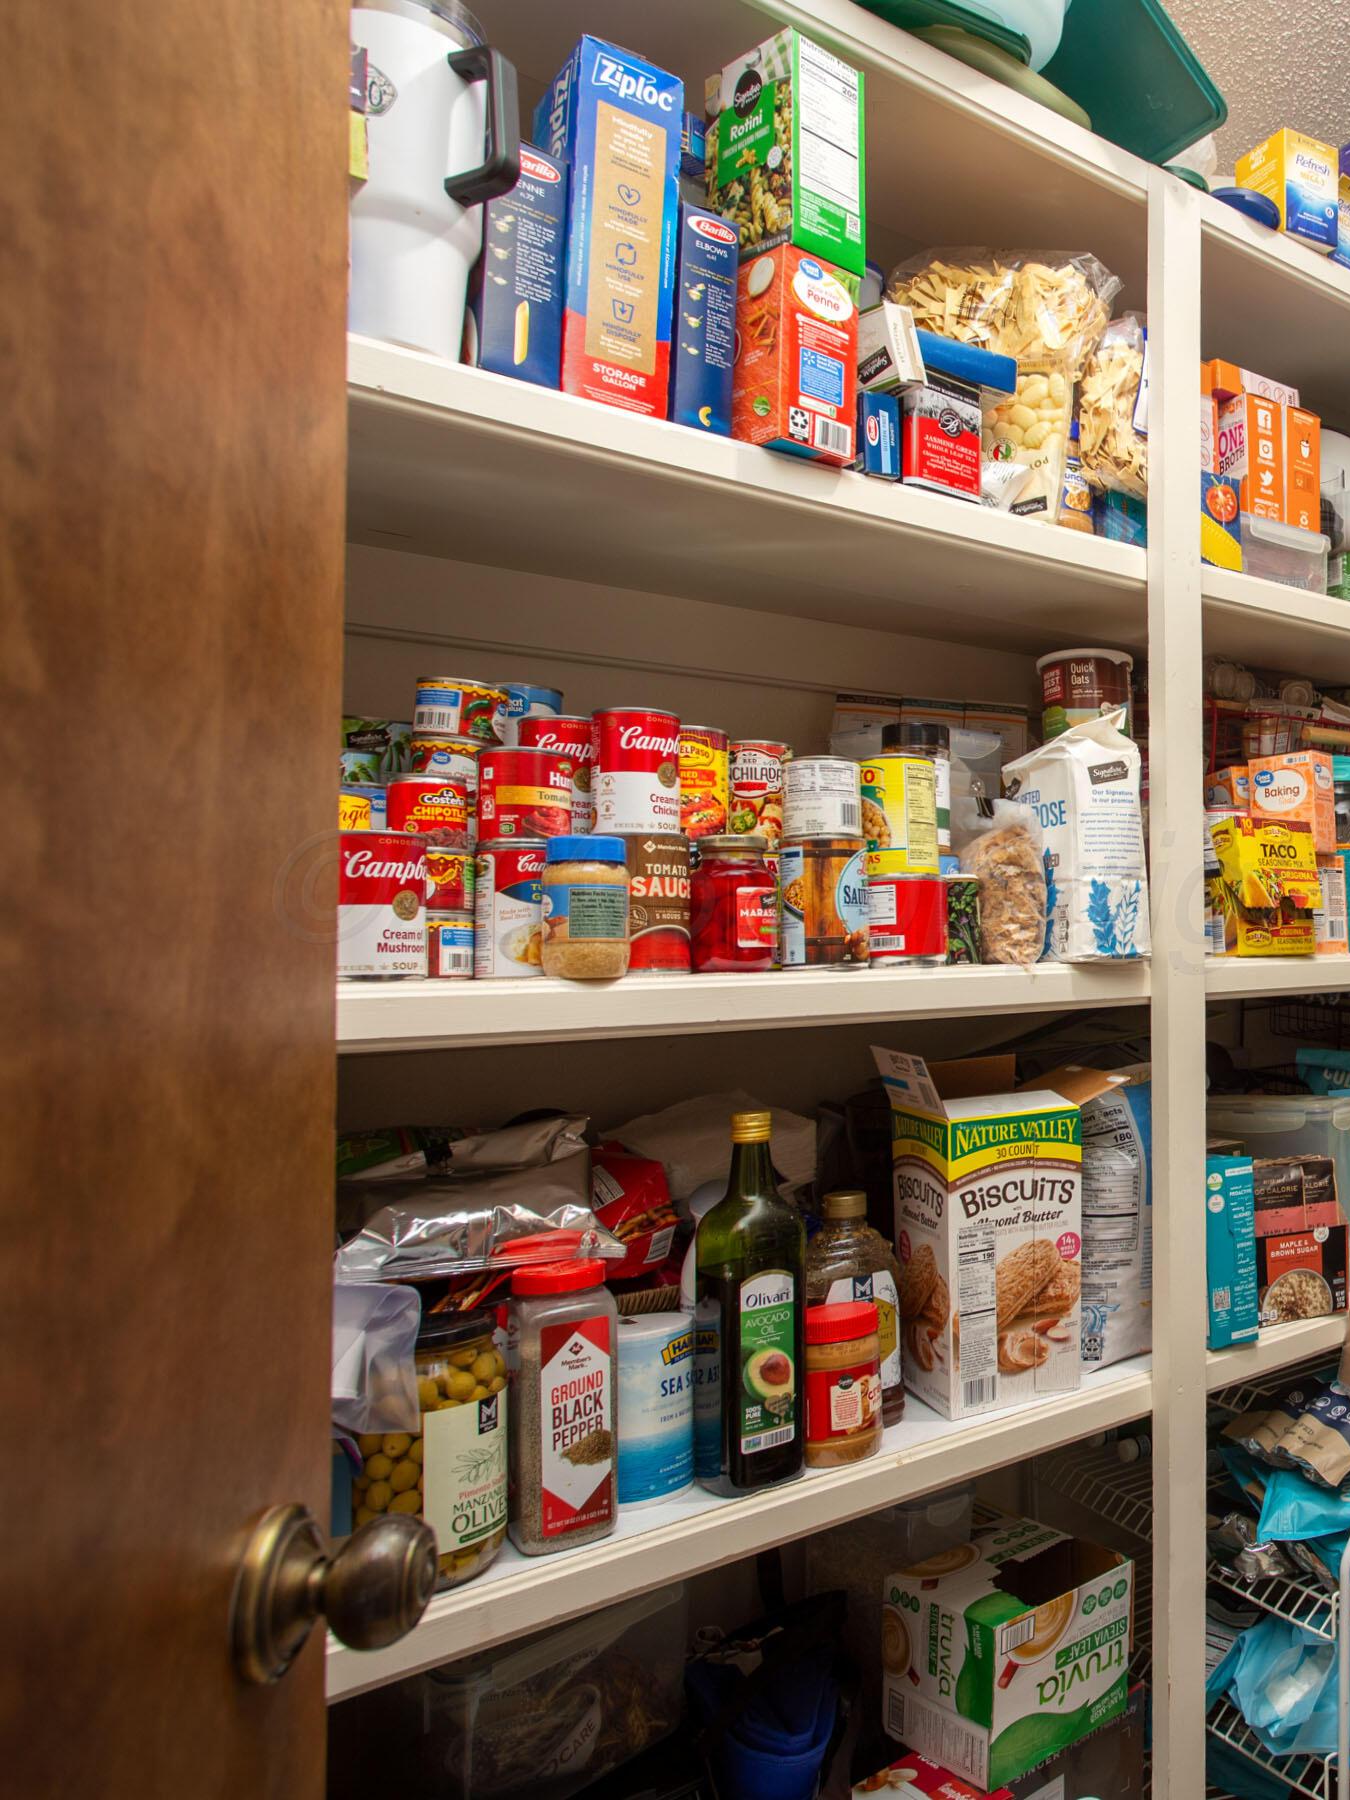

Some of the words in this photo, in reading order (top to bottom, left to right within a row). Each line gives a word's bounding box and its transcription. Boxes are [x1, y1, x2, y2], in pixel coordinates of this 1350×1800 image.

[600, 57, 673, 112] Ziploc
[730, 109, 763, 142] Rotini
[1295, 154, 1330, 177] Refresh
[699, 221, 734, 242] Barilla
[695, 239, 728, 258] ELBOWS
[807, 290, 840, 312] Penne
[593, 362, 647, 387] STORAGE
[601, 374, 636, 391] GALLON
[923, 434, 954, 449] JASMINE
[955, 443, 977, 458] GREEN
[1218, 423, 1245, 458] ONE
[926, 443, 948, 454] WHOLE
[950, 450, 963, 460] LEAF
[1219, 446, 1245, 476] BROTH
[1070, 662, 1094, 674] Quick
[1044, 678, 1060, 689] BEST
[1071, 673, 1090, 686] Oats
[443, 789, 453, 798] La
[1105, 789, 1134, 797] Signature
[1264, 784, 1300, 798] Baking
[1111, 797, 1134, 805] promise
[657, 822, 677, 830] SOUP
[1241, 819, 1252, 829] 10
[1260, 843, 1298, 859] TACO
[645, 863, 688, 876] TOMATO
[1257, 857, 1291, 868] SEASONING
[1292, 859, 1304, 868] MIX
[1280, 871, 1314, 881] ORIGINAL
[382, 929, 416, 940] Cream
[1279, 928, 1305, 936] ORIGINAL
[1276, 936, 1302, 945] SEASONING
[392, 961, 419, 971] SOUP
[895, 1113, 919, 1143] NATURE
[919, 1123, 944, 1153] VALLEY
[955, 1122, 1018, 1157] NATURE
[1020, 1117, 1078, 1143] VALLEY
[1113, 1131, 1132, 1143] 180
[996, 1147, 1007, 1159] 30
[1008, 1144, 1041, 1157] COUNT
[1267, 1185, 1298, 1195] CALORIE
[1022, 1209, 1064, 1223] Butter
[1270, 1249, 1296, 1258] BROWN
[1296, 1245, 1319, 1255] SUGAR
[1279, 1240, 1304, 1249] MAPLE
[982, 1252, 995, 1260] 190
[745, 1286, 791, 1308] Olivari
[745, 1310, 791, 1331] AVOCADO
[760, 1325, 775, 1336] OIL
[550, 1370, 604, 1406] GROUND
[660, 1375, 683, 1398] SEA
[551, 1391, 604, 1431] BLACK
[745, 1411, 762, 1421] PURE
[551, 1414, 604, 1452] PEPPER
[929, 1603, 939, 1641] STEVIA
[1093, 1616, 1128, 1648] STEVIA
[928, 1641, 938, 1666] LEAF
[1066, 1637, 1092, 1663] LEAF
